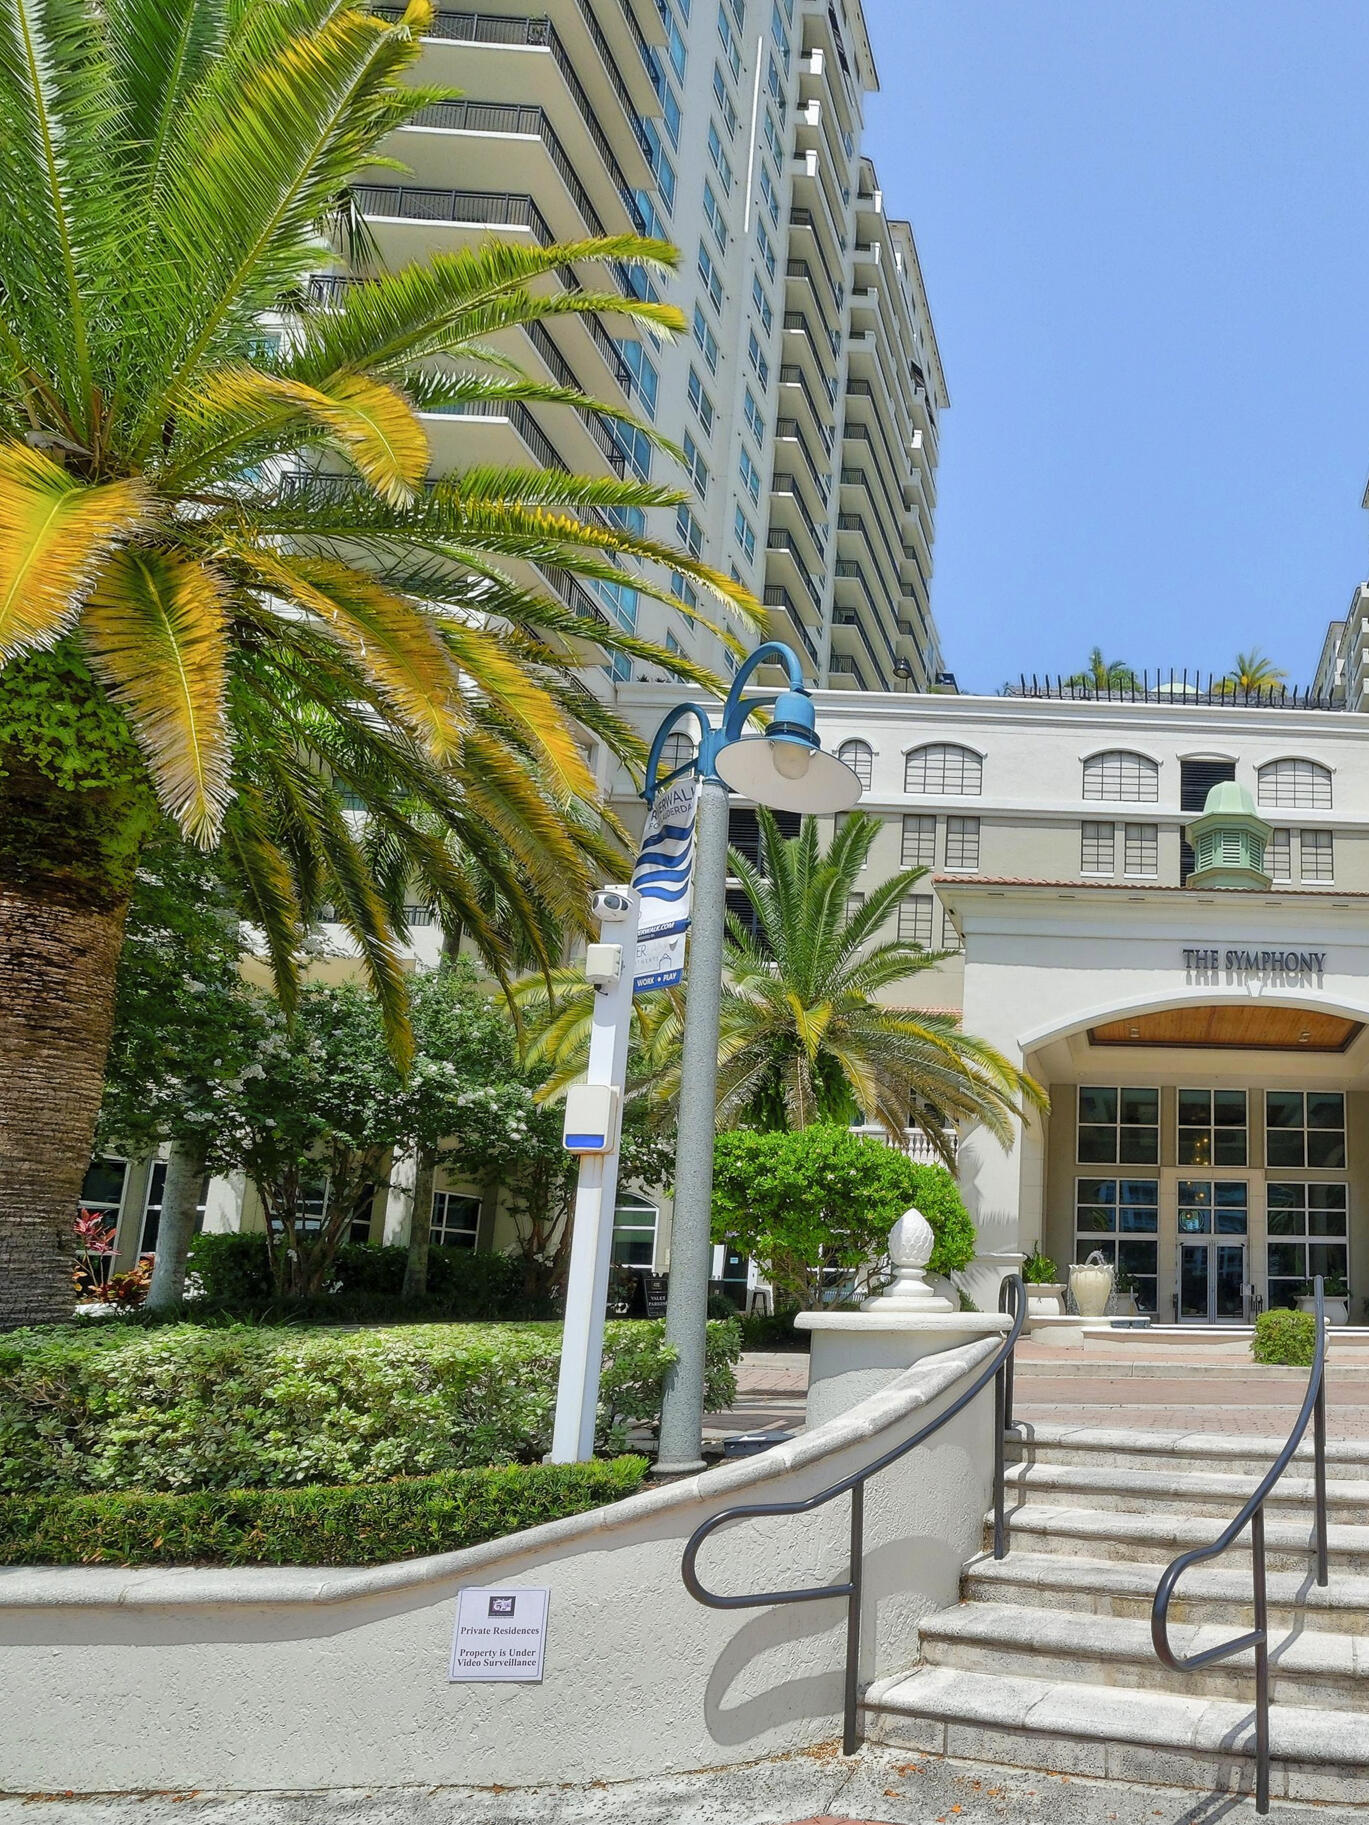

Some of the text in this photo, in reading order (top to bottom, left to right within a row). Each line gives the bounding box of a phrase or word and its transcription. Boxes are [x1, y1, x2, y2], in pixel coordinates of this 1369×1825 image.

[637, 922, 675, 936] ERWALK.COM
[1182, 949, 1327, 973] THE SYMPHONY
[637, 972, 677, 987] WORK PLAY
[460, 1626, 540, 1635] Private Residences
[459, 1648, 537, 1659] Property is Under
[457, 1658, 537, 1667] Video Surveillance
